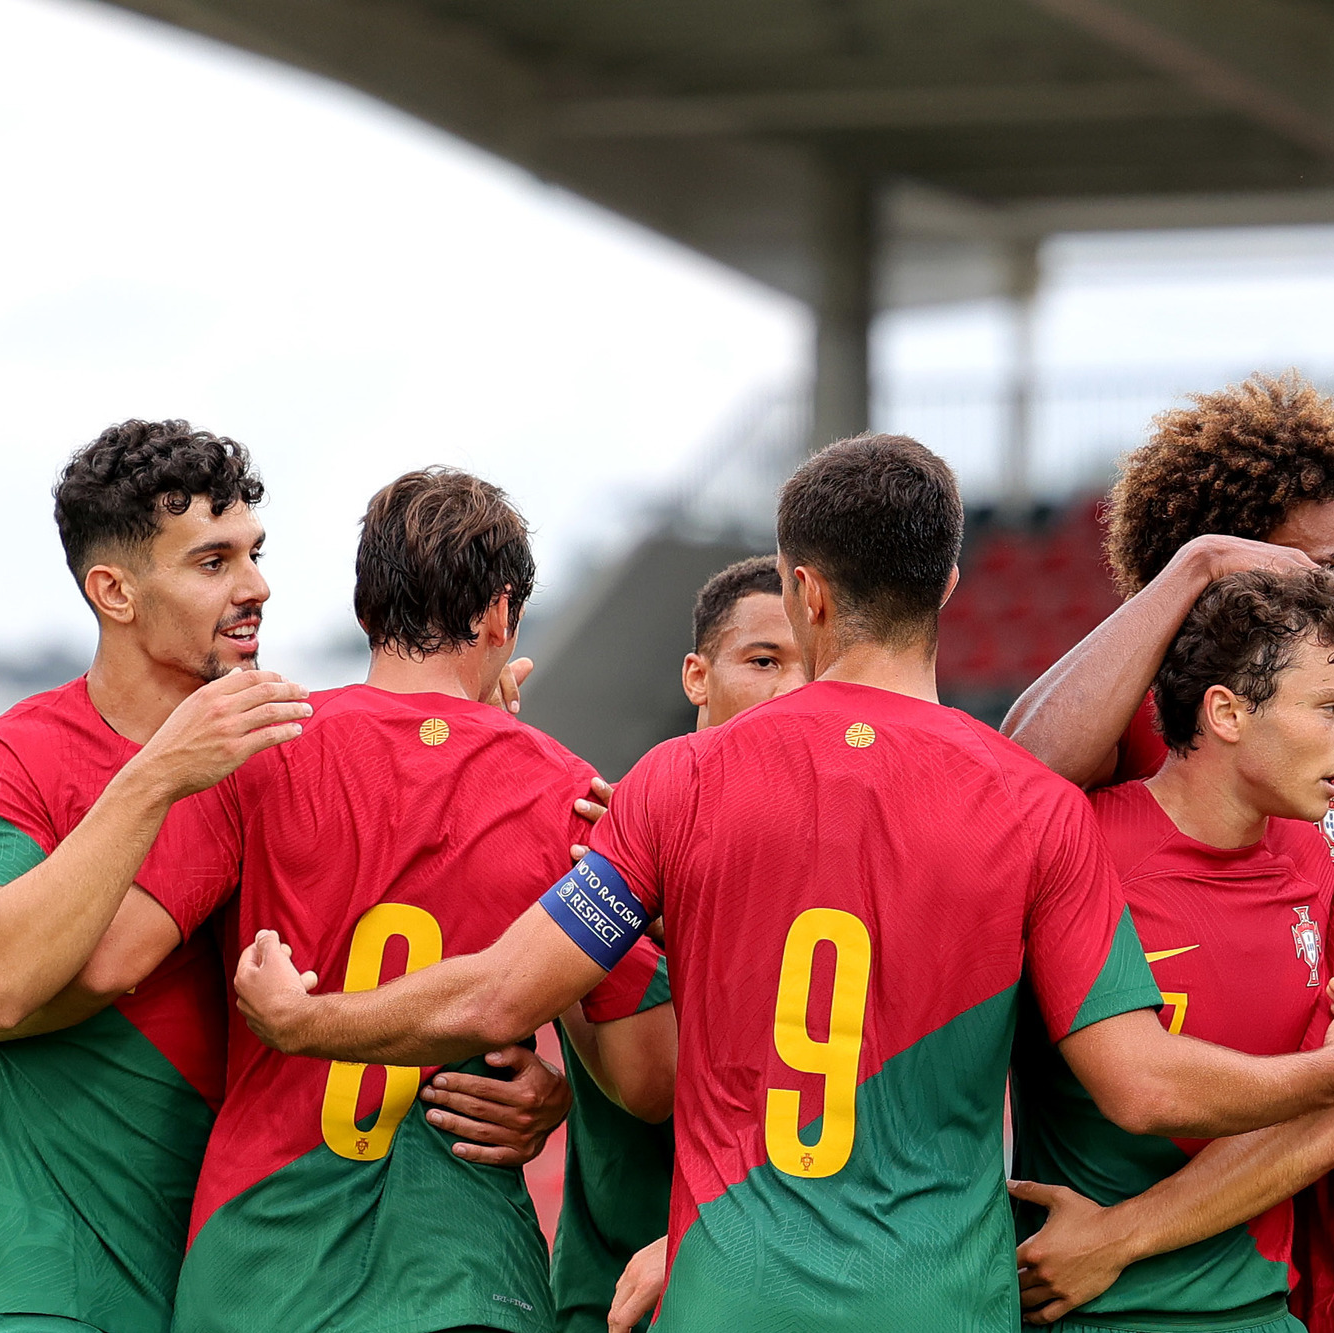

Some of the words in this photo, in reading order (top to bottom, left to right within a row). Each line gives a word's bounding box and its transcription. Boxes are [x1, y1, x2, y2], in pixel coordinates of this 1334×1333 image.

[570, 893, 622, 942] RESPECT
[576, 860, 589, 876] NO
[585, 871, 601, 889] TO
[598, 886, 643, 930] RACISM
[765, 907, 872, 1179] 9
